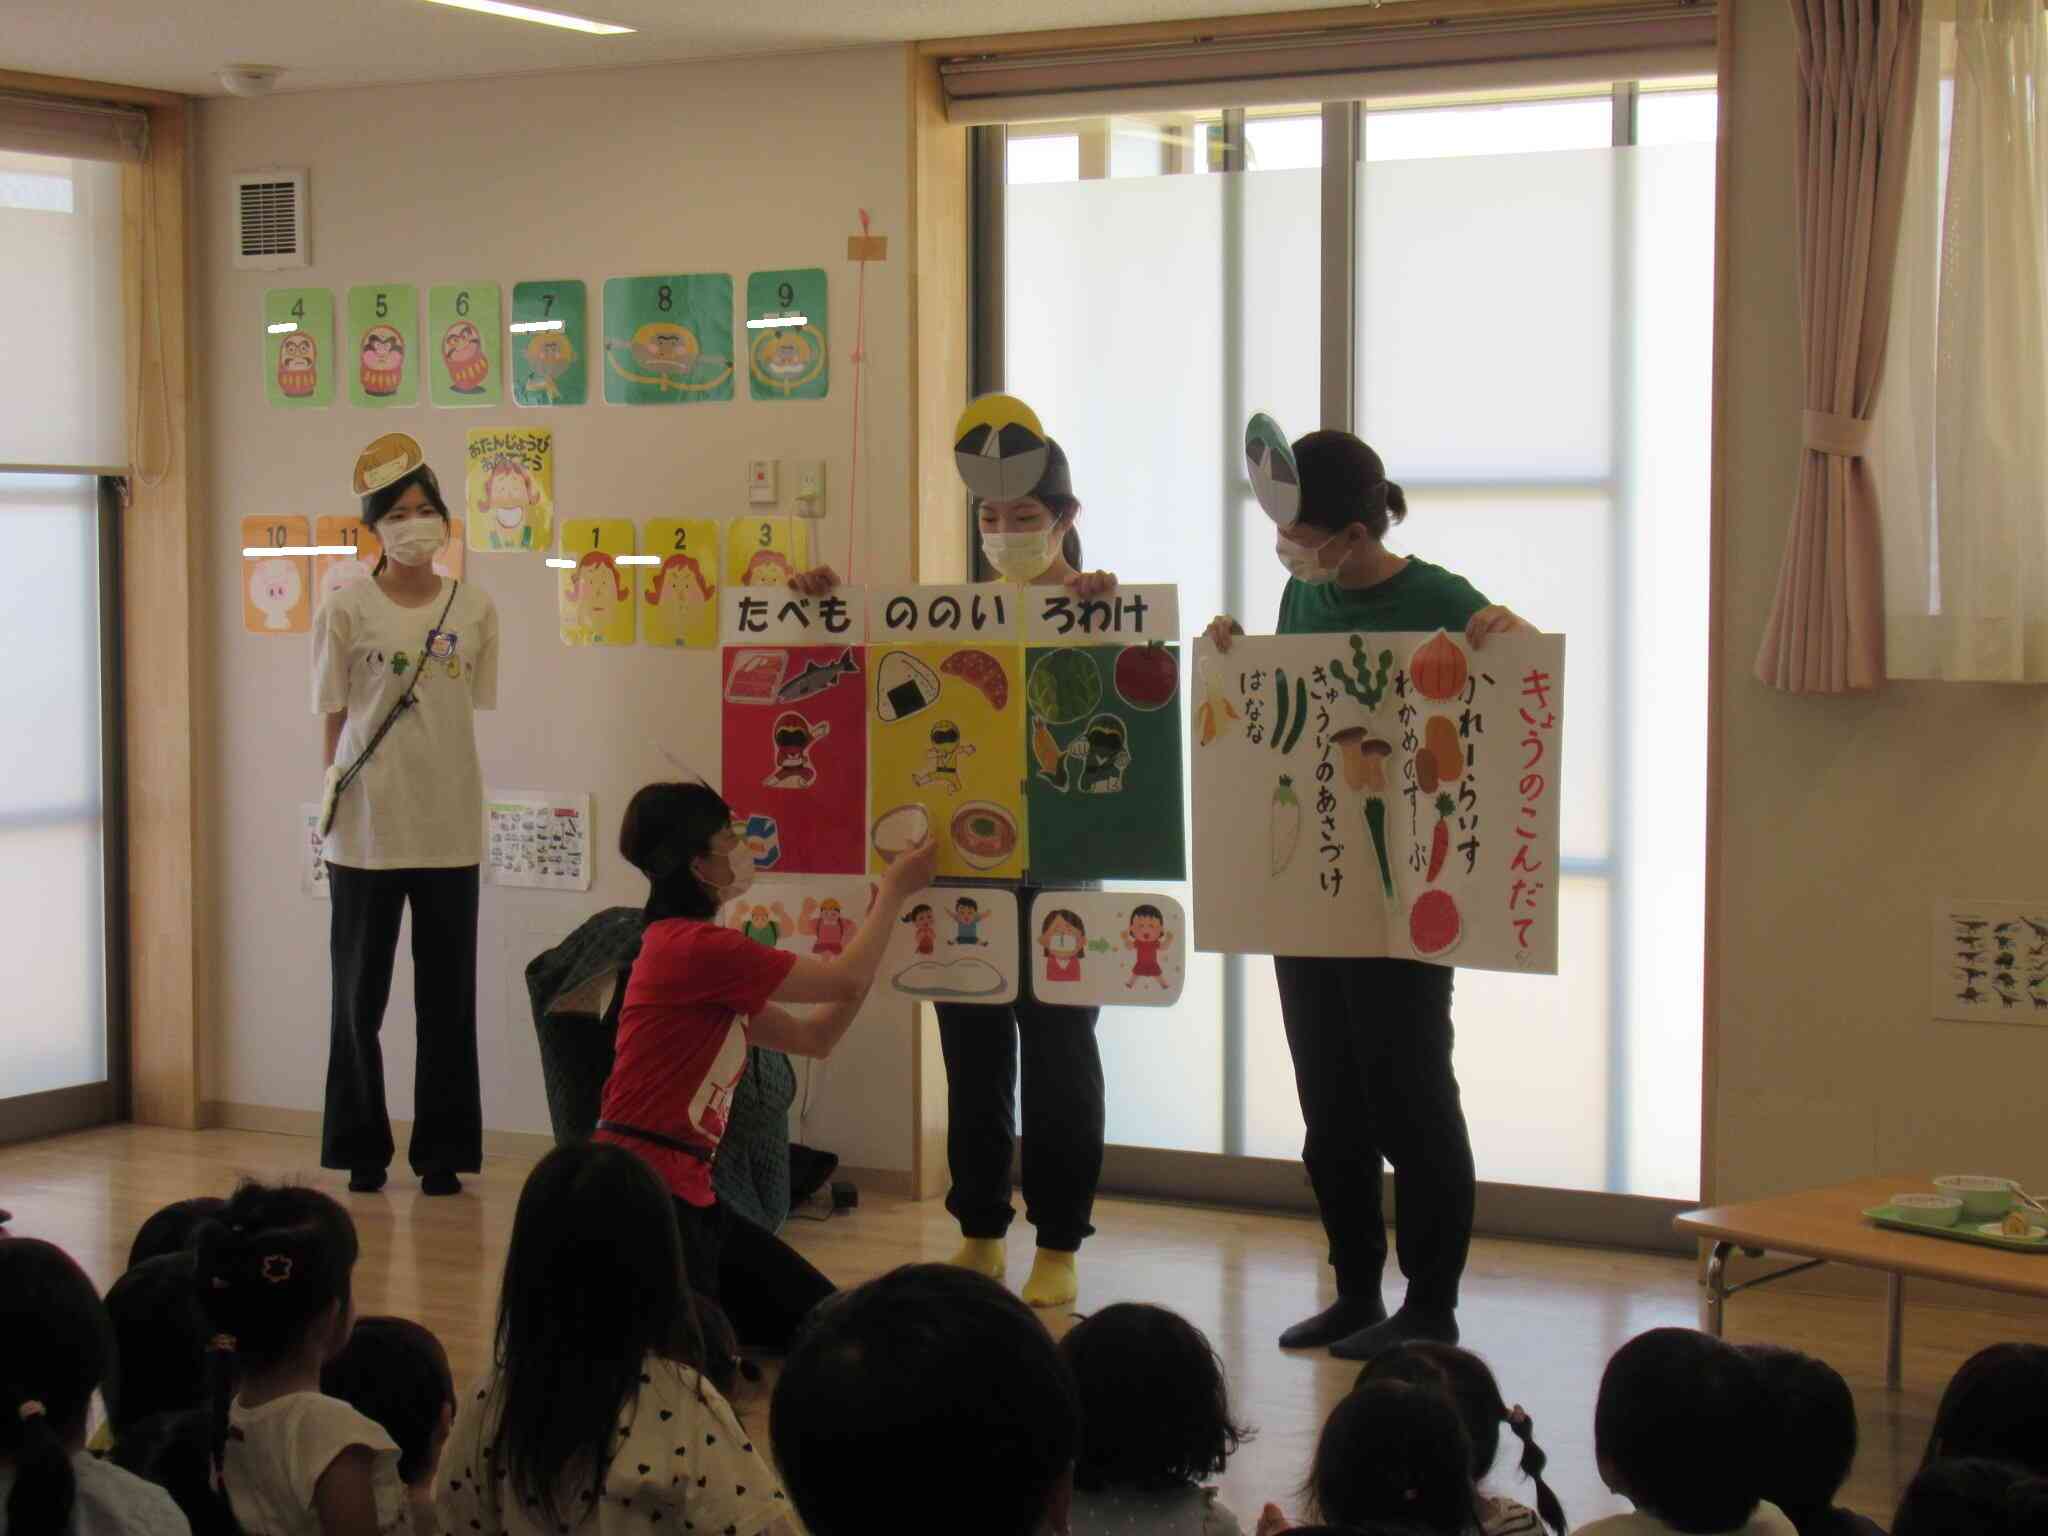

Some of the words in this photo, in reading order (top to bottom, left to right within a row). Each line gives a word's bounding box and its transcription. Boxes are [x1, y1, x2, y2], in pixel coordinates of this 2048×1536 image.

[375, 293, 388, 318] 5
[456, 291, 470, 317] 6
[542, 294, 555, 317] 7
[657, 285, 673, 312] 8
[778, 283, 794, 308] 9
[291, 298, 305, 319] 4
[266, 525, 288, 548] 10
[340, 527, 359, 548] 11
[591, 527, 601, 549] 1
[674, 527, 687, 550] 2
[759, 523, 773, 547] 3
[1240, 670, 1266, 745] ばなな
[1311, 665, 1344, 898] きゅうりのあさづけ
[1510, 669, 1555, 949] きょうのこんだて
